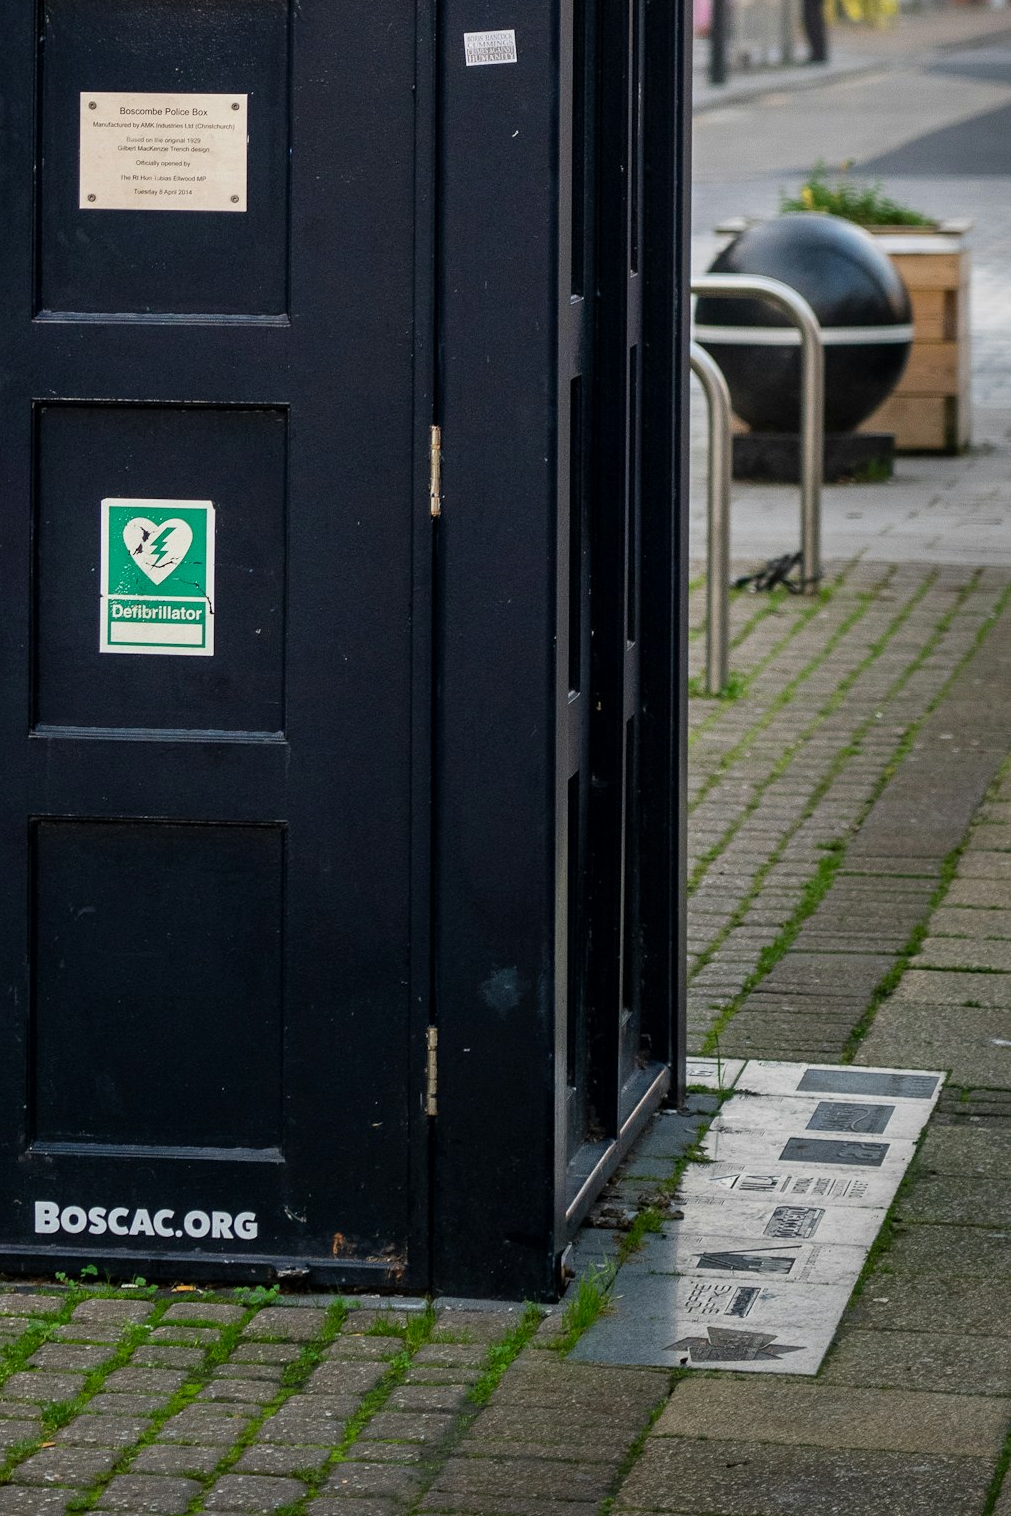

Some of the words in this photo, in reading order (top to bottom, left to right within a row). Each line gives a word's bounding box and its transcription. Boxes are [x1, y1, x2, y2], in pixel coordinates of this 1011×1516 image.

[120, 107, 163, 116] Boscombe
[165, 108, 190, 116] Police
[192, 108, 208, 116] Box
[112, 604, 202, 621] Defibrillator
[35, 1201, 258, 1240] BOSCAC.ORG
